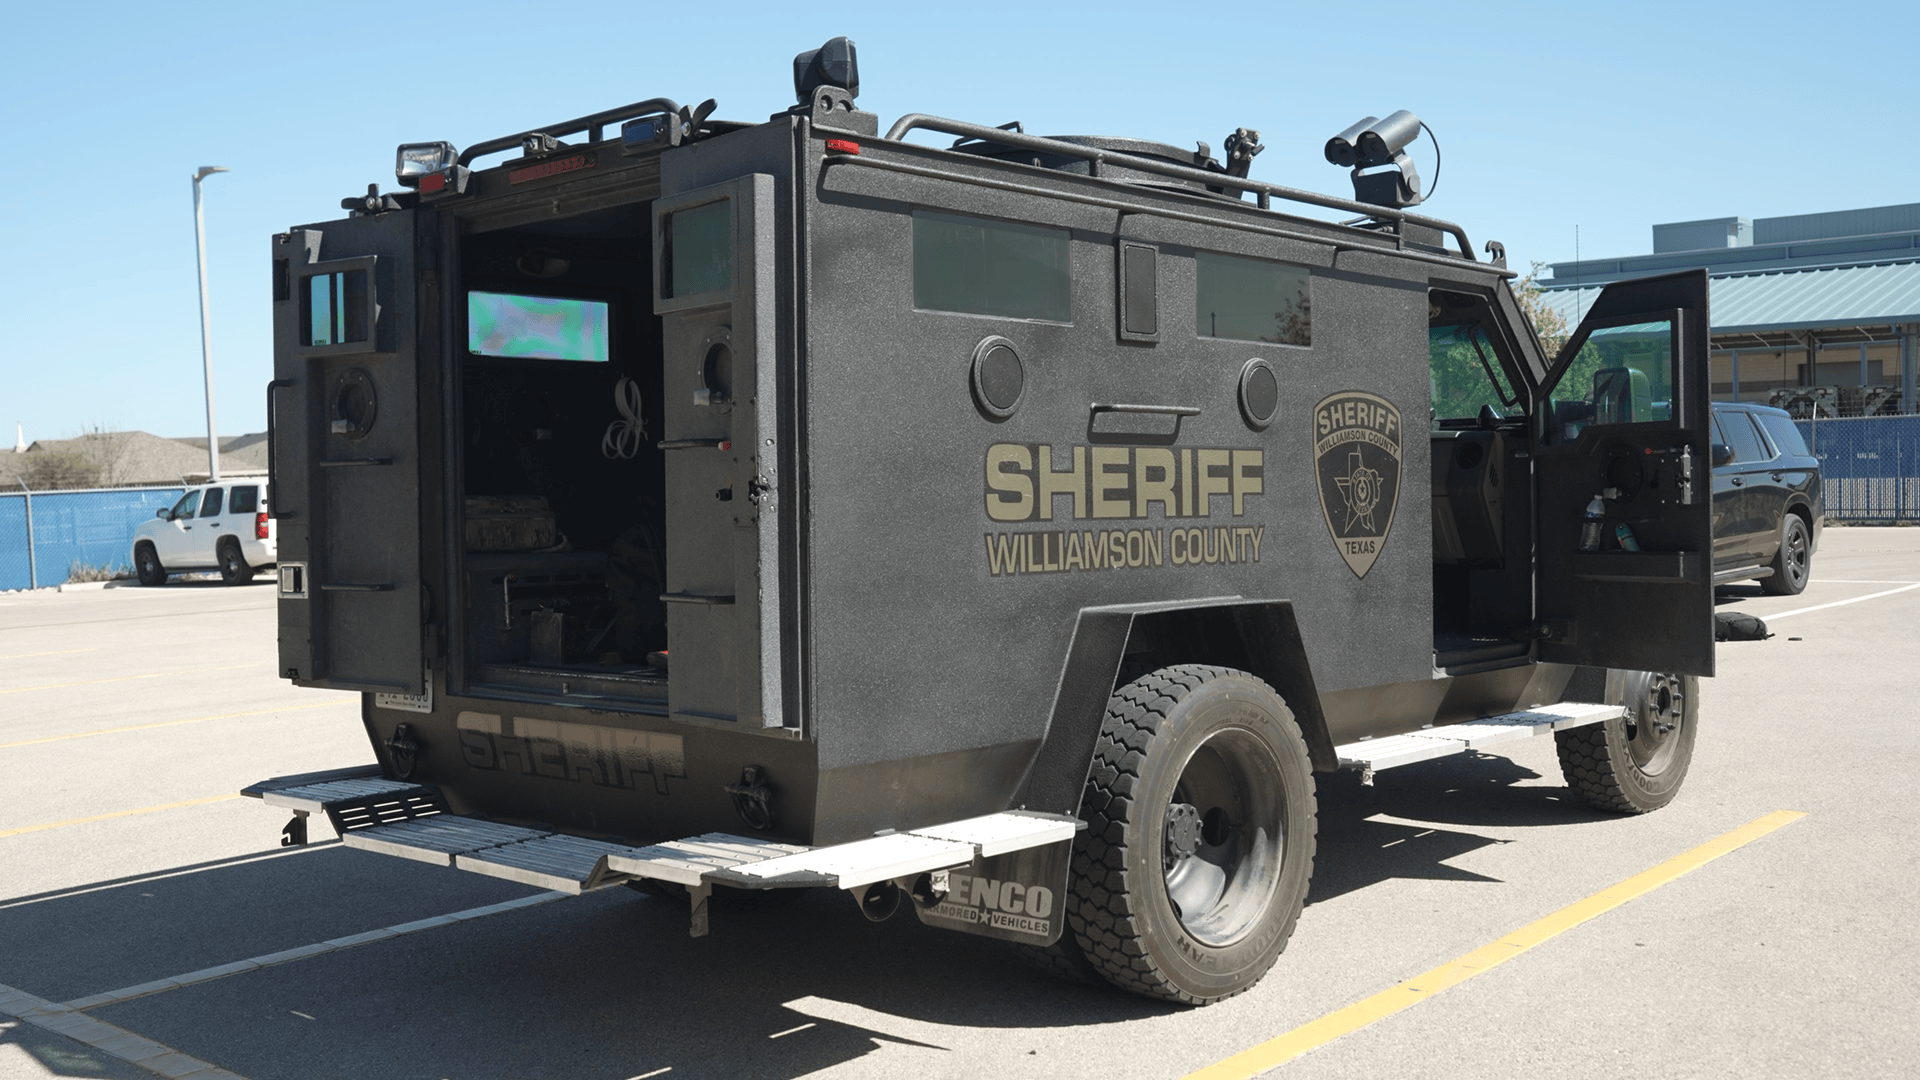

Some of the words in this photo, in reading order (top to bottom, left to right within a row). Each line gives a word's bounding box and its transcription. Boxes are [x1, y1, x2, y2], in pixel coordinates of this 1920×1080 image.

[1318, 402, 1397, 435] SHERIFF
[1318, 430, 1366, 454] WILLIAMSON
[1368, 432, 1398, 456] COUNTY
[985, 443, 1265, 521] SHERIFF
[985, 530, 1164, 575] WILLIAMSON
[1171, 527, 1265, 567] COUNTY
[1345, 541, 1376, 556] TEXAS
[456, 711, 687, 796] SHERIFF
[945, 873, 1053, 918] ENCO
[993, 914, 1048, 933] VEHICLES
